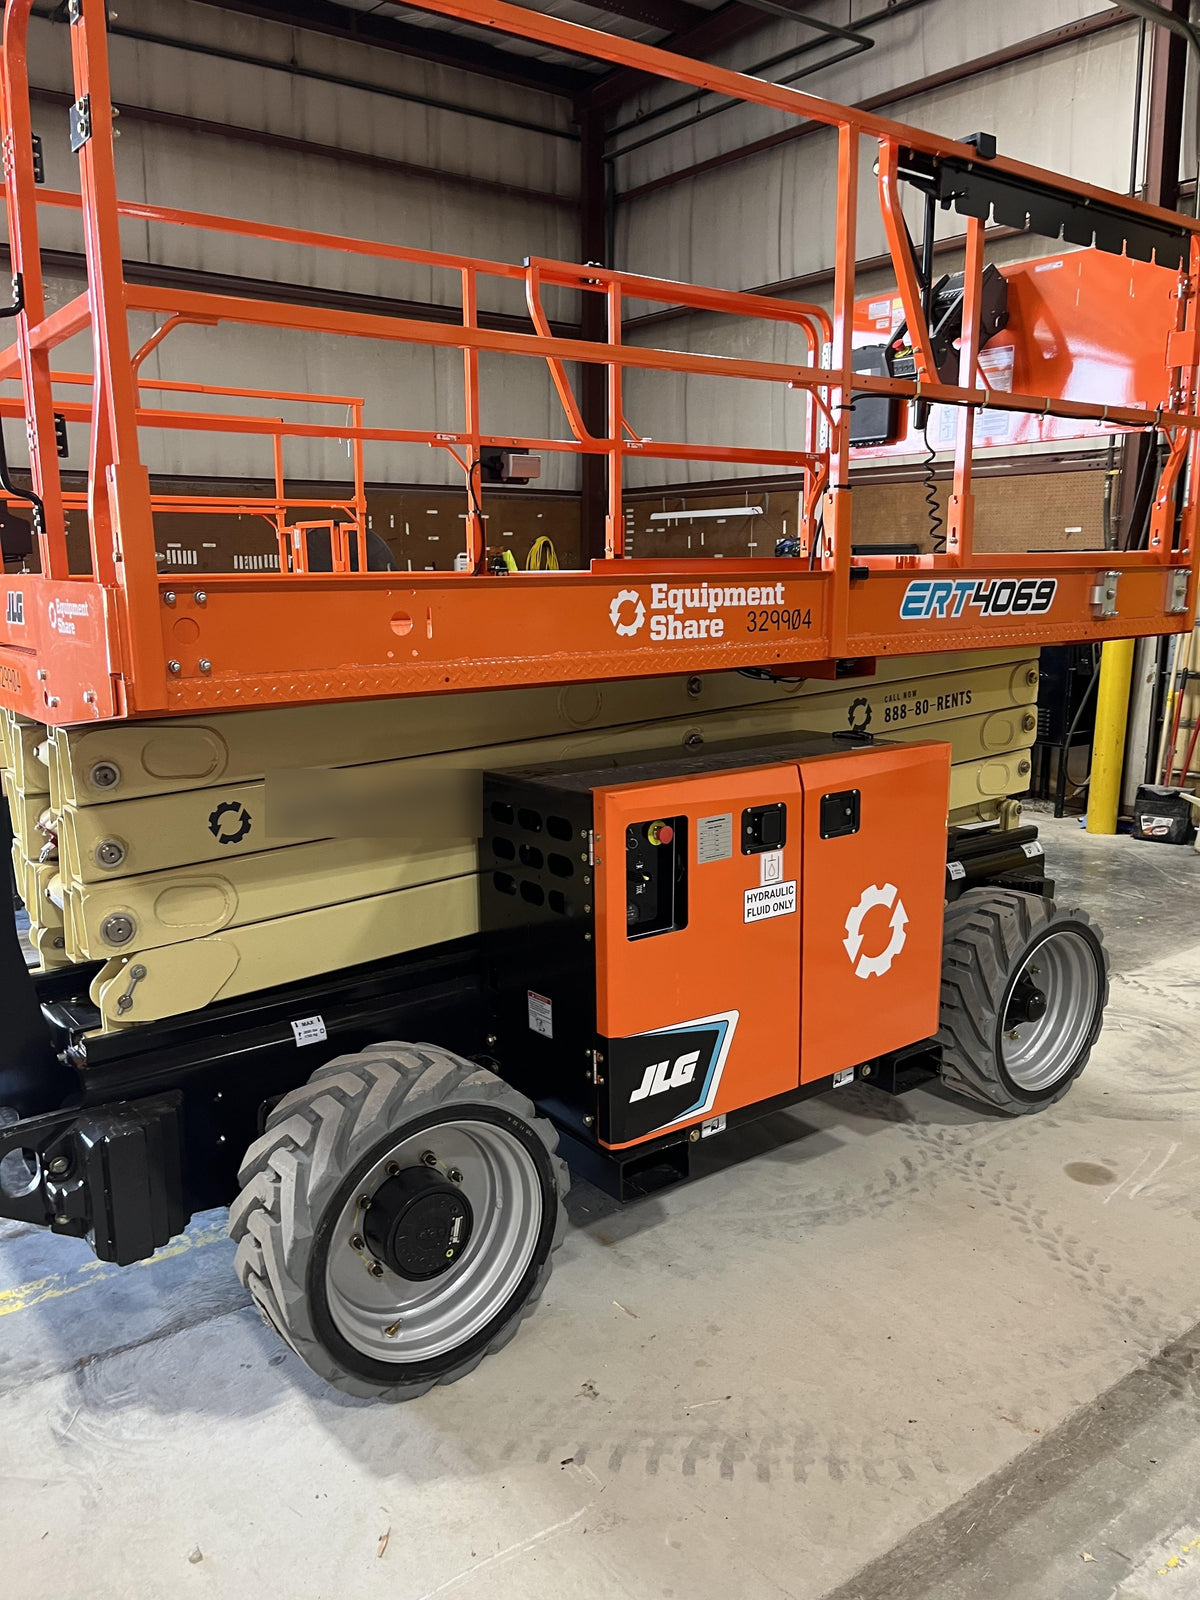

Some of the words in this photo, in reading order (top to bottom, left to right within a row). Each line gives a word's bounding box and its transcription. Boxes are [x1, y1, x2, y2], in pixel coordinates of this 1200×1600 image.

[6, 591, 25, 625] JLG
[55, 598, 89, 619] Equipment
[651, 582, 785, 614] Equipment
[901, 578, 1057, 619] ERT4069
[57, 617, 76, 635] Share
[650, 615, 724, 641] Share
[747, 608, 812, 633] 329904
[884, 694, 900, 703] CALL
[903, 690, 917, 699] NOW
[884, 690, 972, 722] 888-80-RENTS
[747, 885, 794, 903] HYDRAULIC
[747, 904, 770, 917] FLUID
[772, 899, 794, 910] ONLY
[629, 1050, 701, 1103] JLG
